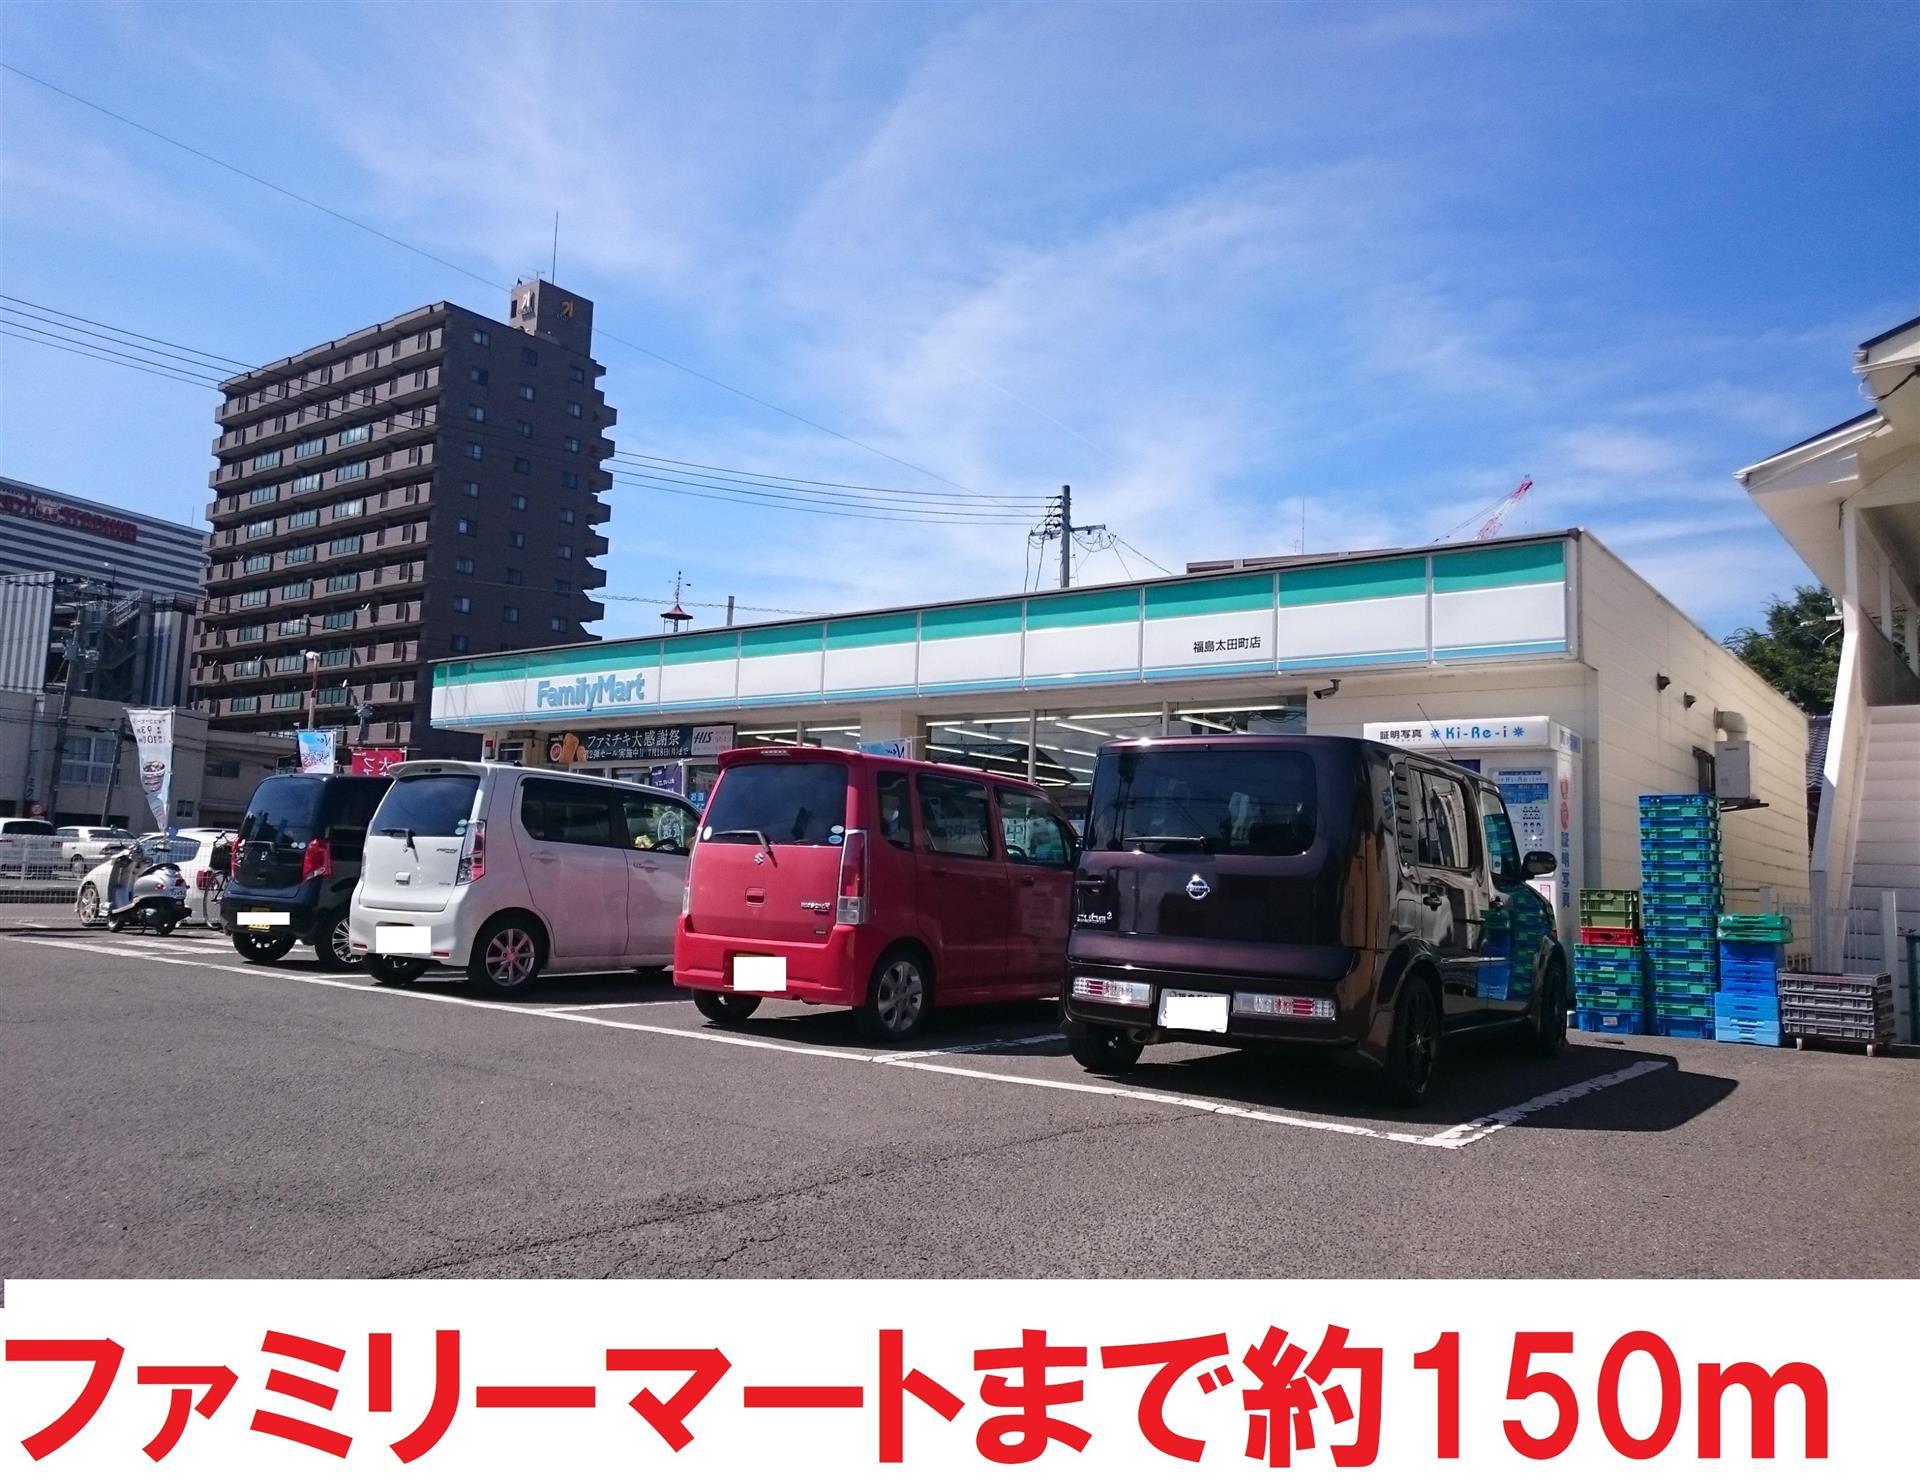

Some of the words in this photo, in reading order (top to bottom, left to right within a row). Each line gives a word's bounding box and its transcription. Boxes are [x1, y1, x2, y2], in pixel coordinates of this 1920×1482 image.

[1193, 636, 1261, 653] 福島太田町店
[537, 672, 645, 712] FamilyMart
[587, 729, 680, 748] ファミチキ大感謝祭
[1379, 729, 1422, 740] 証明写真
[1445, 726, 1507, 739] Ki-Re-i
